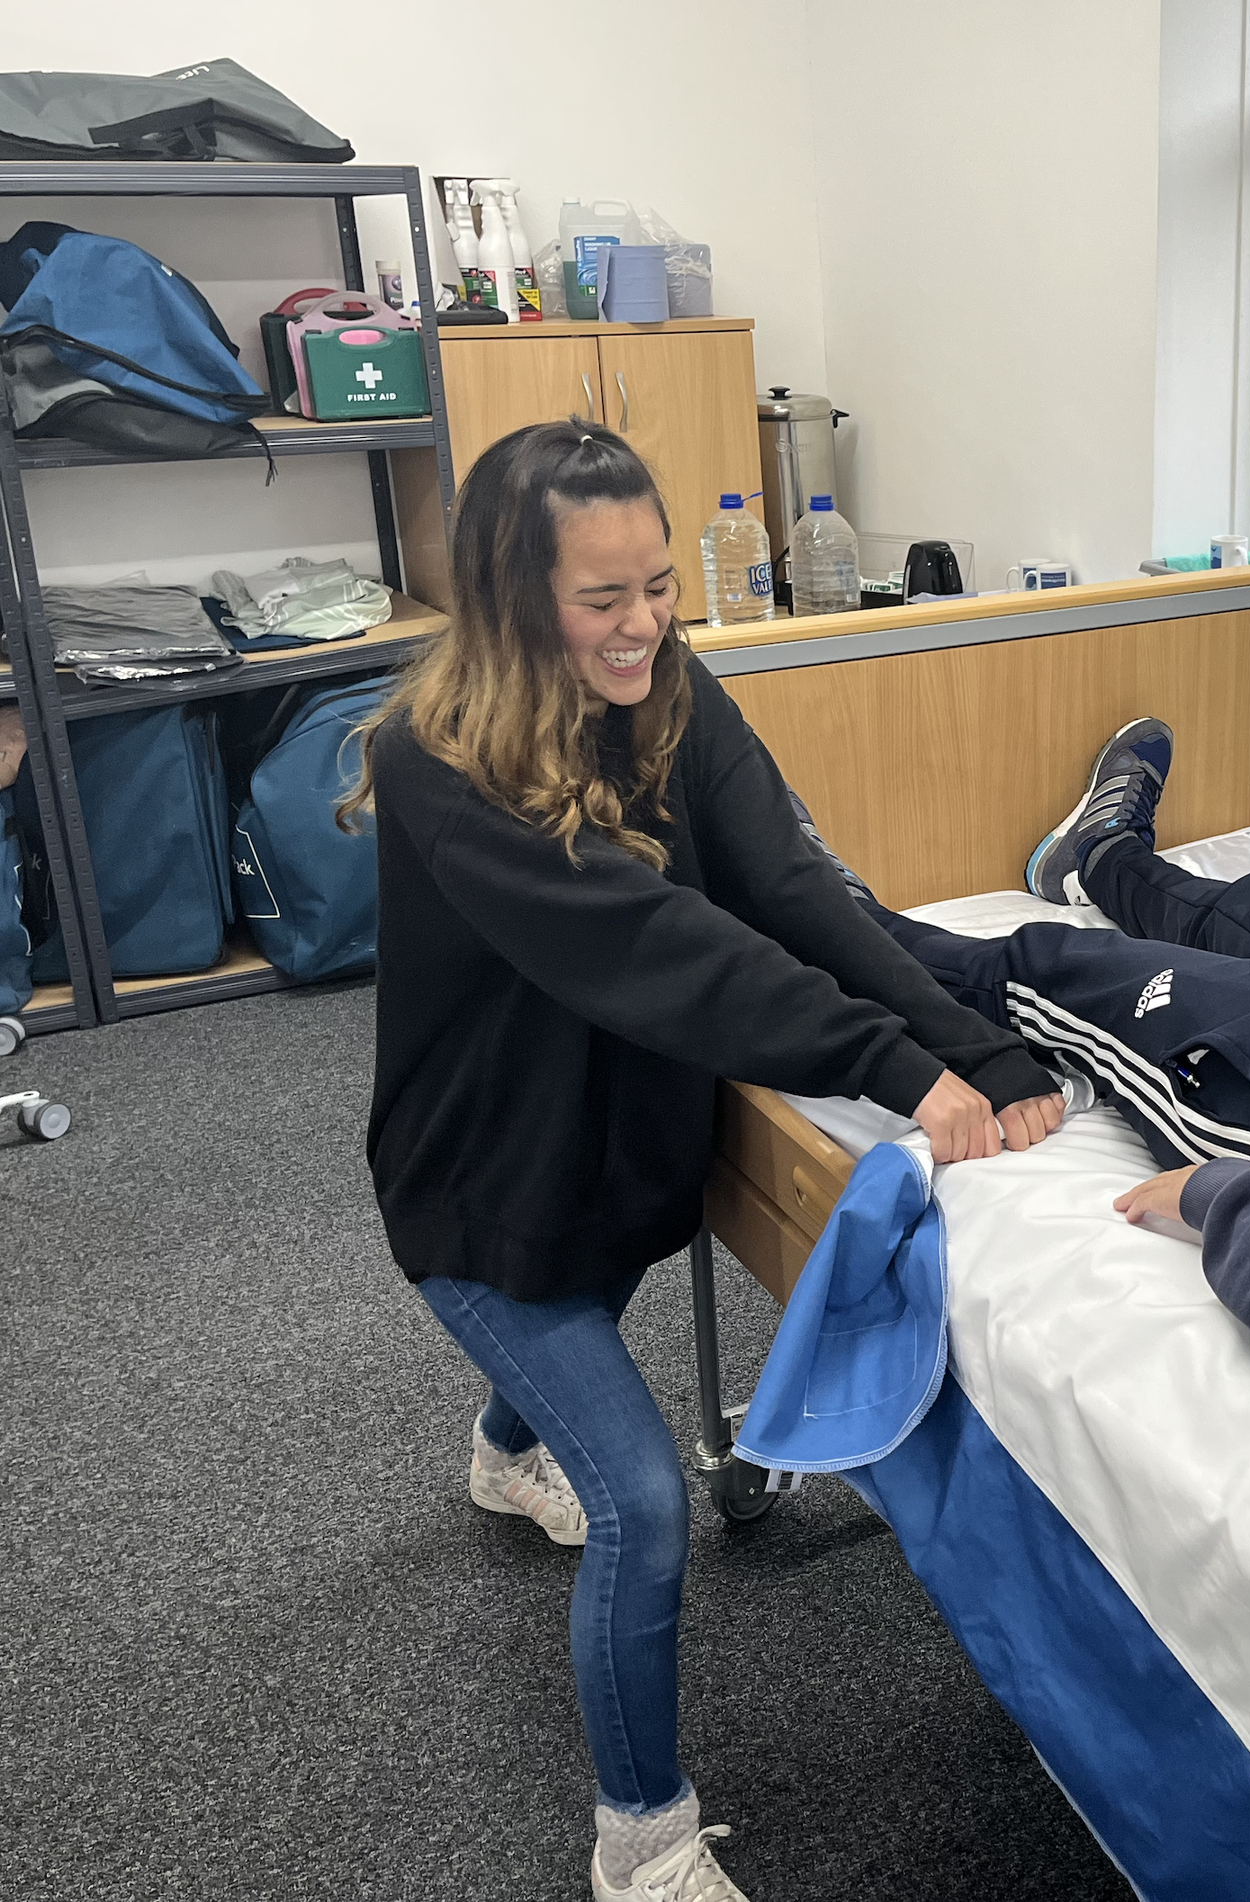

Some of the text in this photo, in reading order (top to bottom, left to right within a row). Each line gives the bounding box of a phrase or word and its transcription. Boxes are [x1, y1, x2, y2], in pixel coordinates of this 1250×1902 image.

[347, 392, 397, 402] FIRST AID
[751, 564, 772, 583] ICE
[1133, 968, 1174, 1019] adidas
